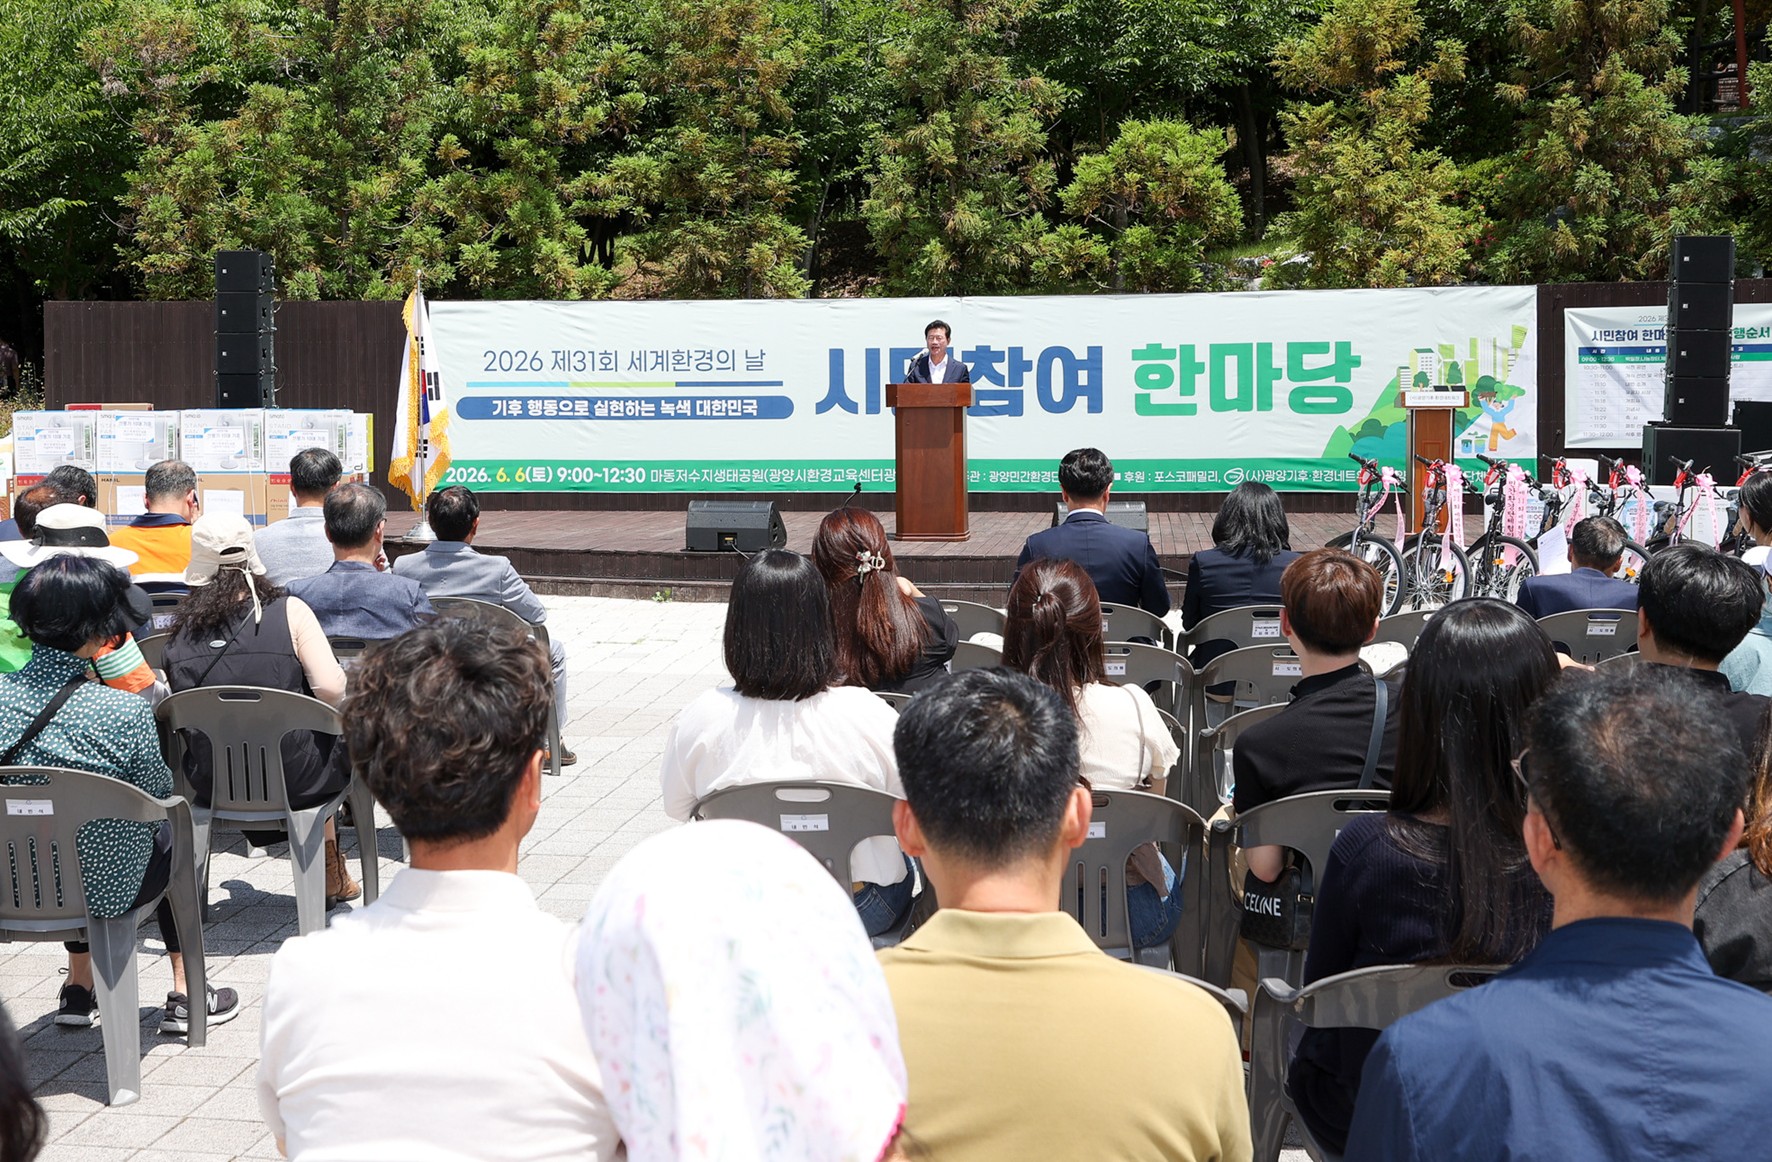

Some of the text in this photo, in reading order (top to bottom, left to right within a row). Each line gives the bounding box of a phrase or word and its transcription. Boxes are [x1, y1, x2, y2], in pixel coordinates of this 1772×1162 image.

[1638, 315, 1657, 323] 2026
[1592, 329, 1638, 342] 시민참여
[483, 348, 767, 373] 2026 제31회 세계환경의 날
[1131, 341, 1362, 417] 한마당
[492, 399, 759, 417] 기후 행동으로 실현하는 녹색 대한민국
[445, 467, 492, 483] 2026.
[496, 467, 511, 483] 6.
[515, 466, 553, 483] 6(토)
[557, 467, 646, 483] 9:00~12:30
[967, 470, 981, 483] 관
[1124, 470, 1146, 483] 후원
[1155, 469, 1221, 484] 포스코패밀리,
[1244, 892, 1282, 917] CELINE
